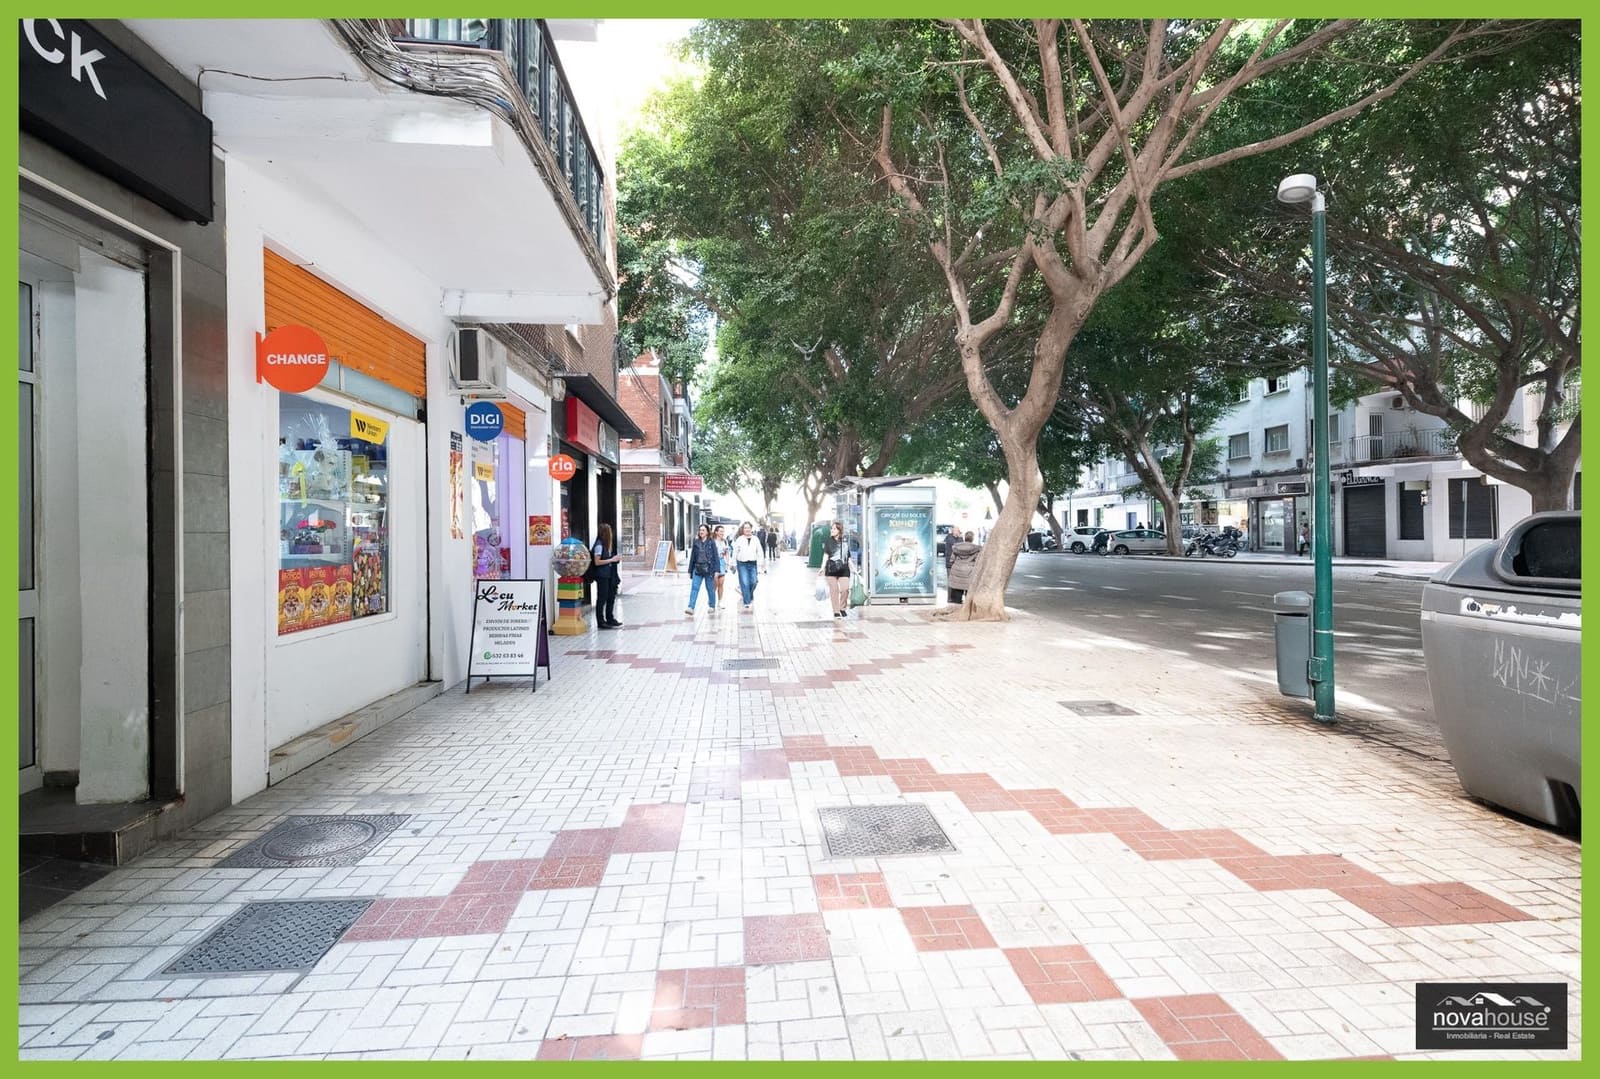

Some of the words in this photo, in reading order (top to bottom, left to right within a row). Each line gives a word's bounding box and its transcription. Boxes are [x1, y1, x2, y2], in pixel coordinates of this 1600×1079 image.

[266, 353, 326, 365] CHANGE
[470, 413, 500, 425] DIGI
[552, 457, 573, 471] ria
